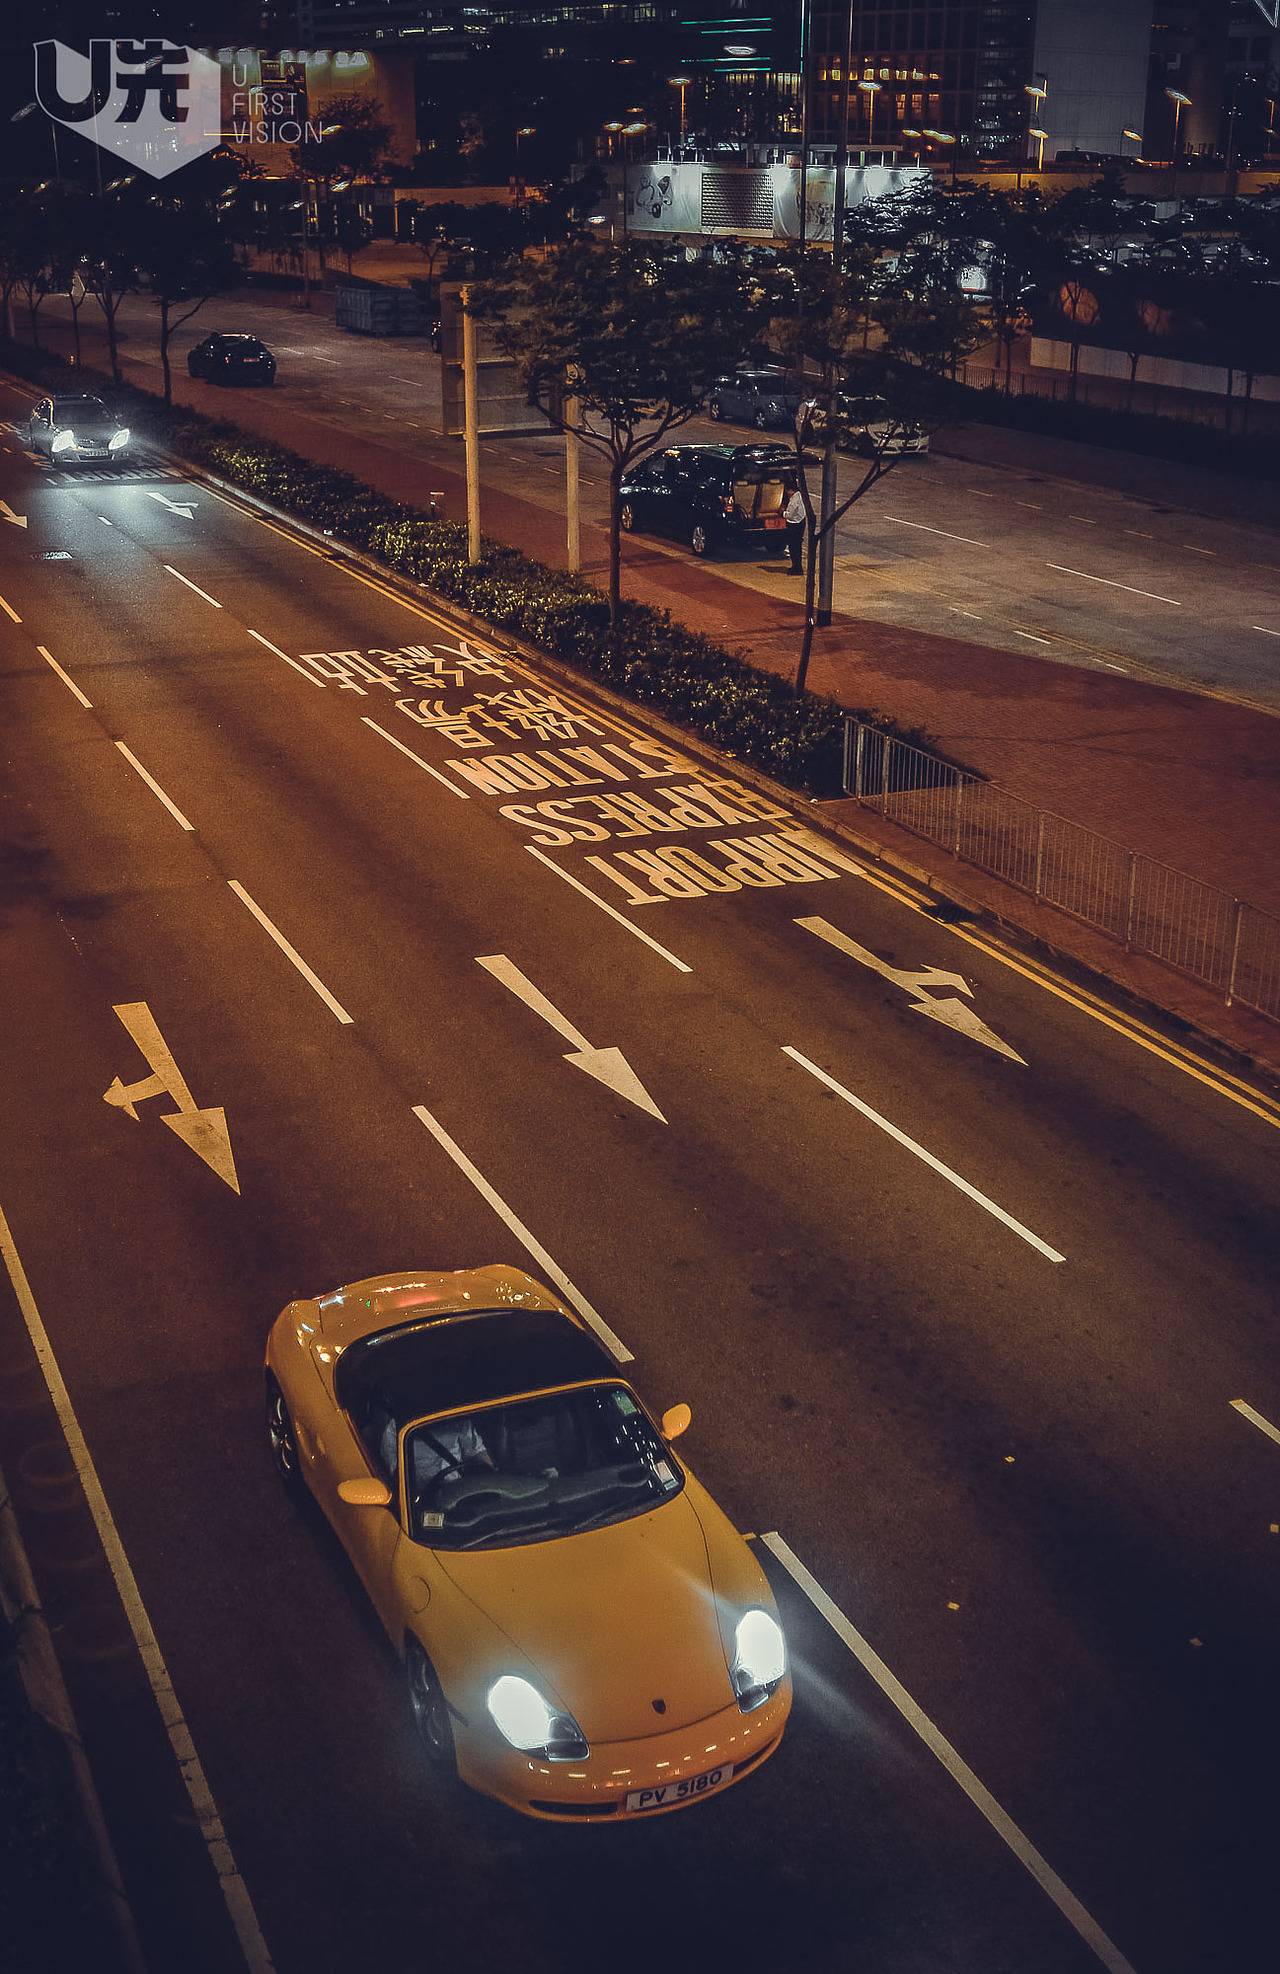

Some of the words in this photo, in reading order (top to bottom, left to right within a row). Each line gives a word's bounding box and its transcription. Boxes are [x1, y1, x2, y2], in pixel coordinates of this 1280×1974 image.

[395, 688, 605, 749] 機場
[445, 740, 700, 796] STATION
[499, 779, 794, 847] EXPRESS
[585, 829, 868, 905] AIRPORT
[639, 1788, 667, 1807] PV
[676, 1770, 722, 1797] 5180
